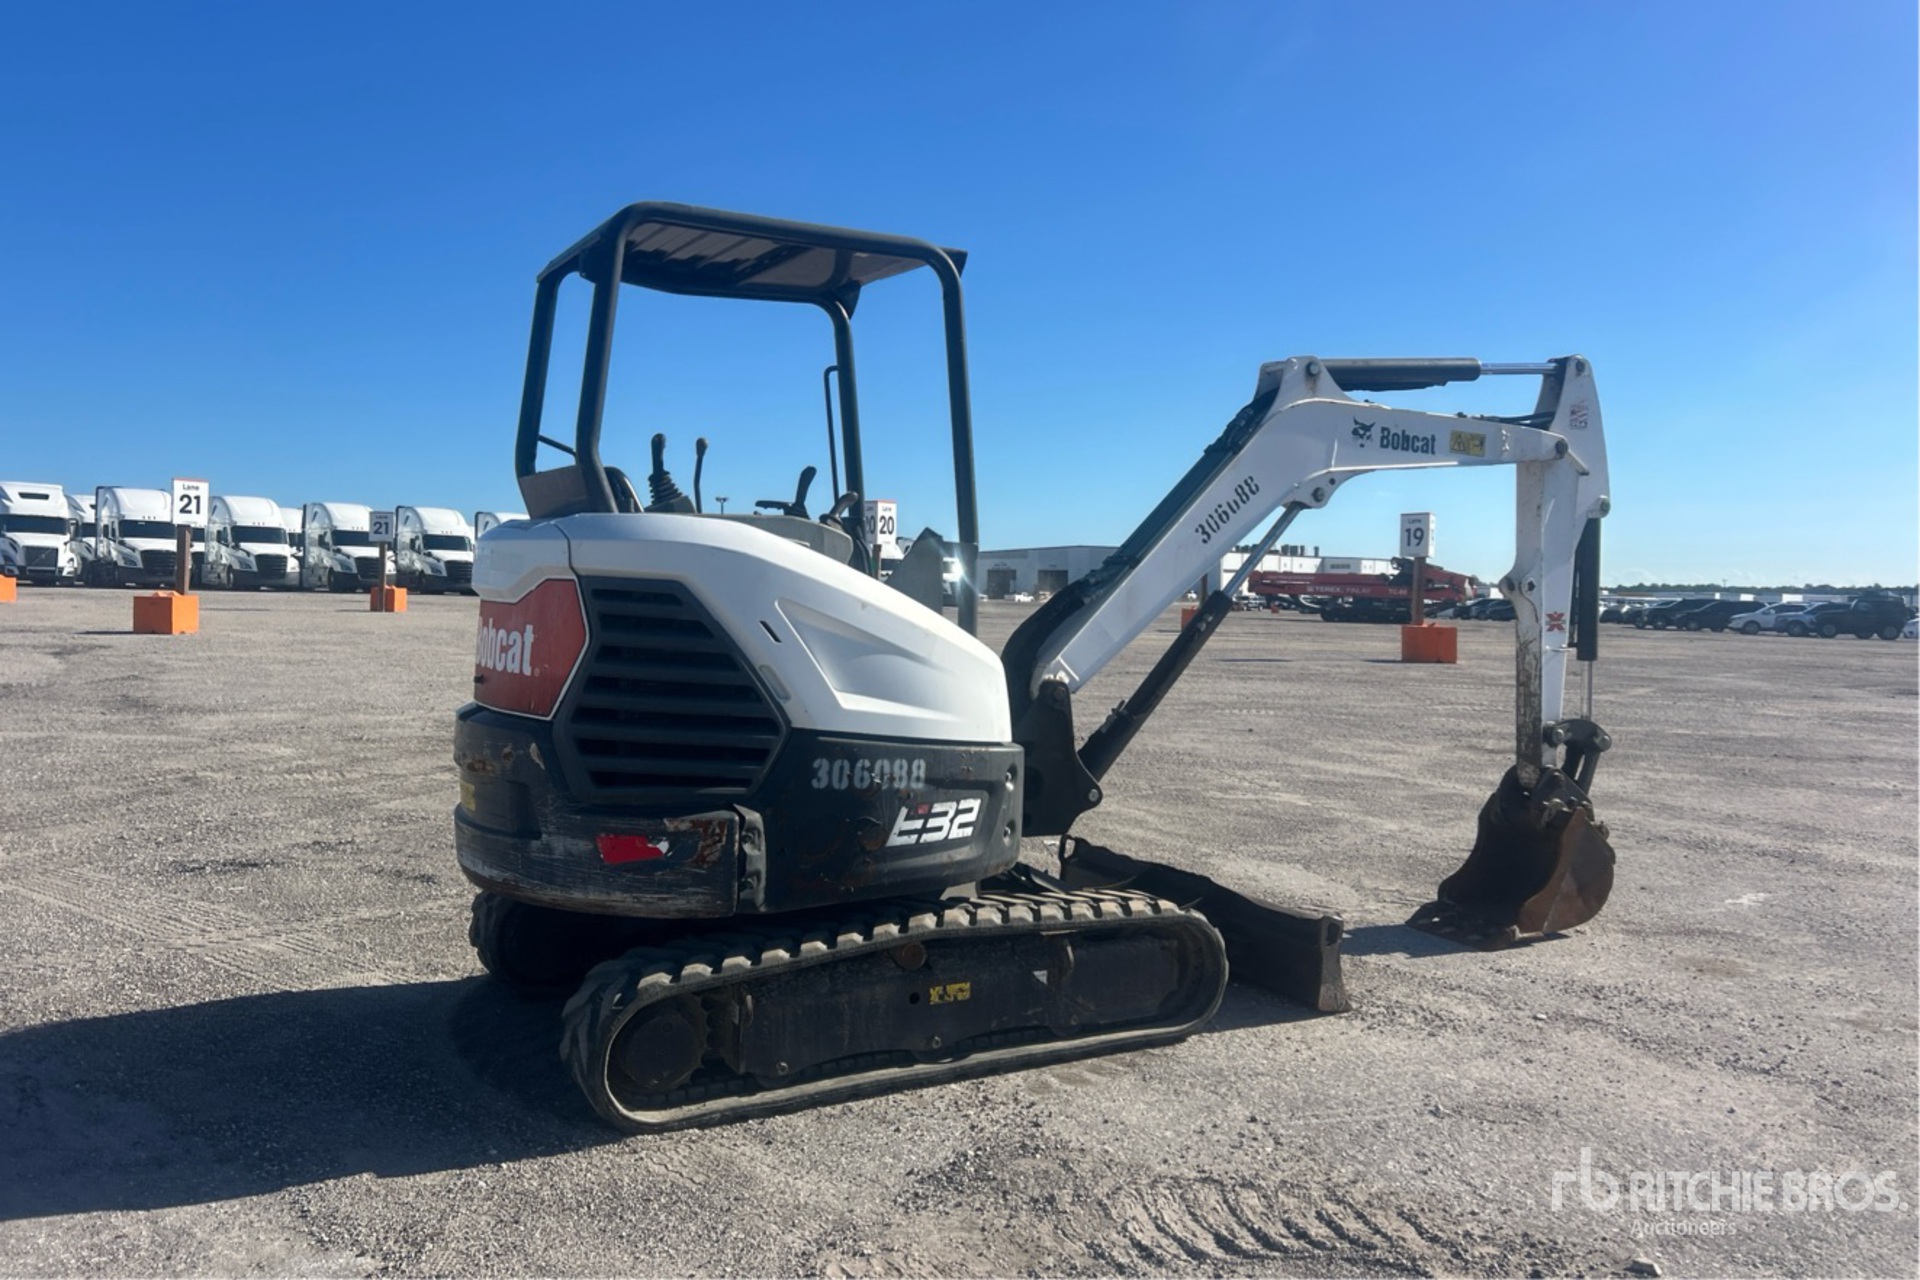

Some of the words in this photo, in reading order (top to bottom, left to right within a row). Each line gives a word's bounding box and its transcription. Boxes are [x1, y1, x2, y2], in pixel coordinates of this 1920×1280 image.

[1380, 426, 1436, 455] Bobcat
[179, 494, 201, 515] 21
[1195, 475, 1260, 544] 306088
[373, 521, 389, 535] 21
[879, 515, 895, 535] 20
[1405, 527, 1425, 547] 19
[886, 798, 982, 847] E32
